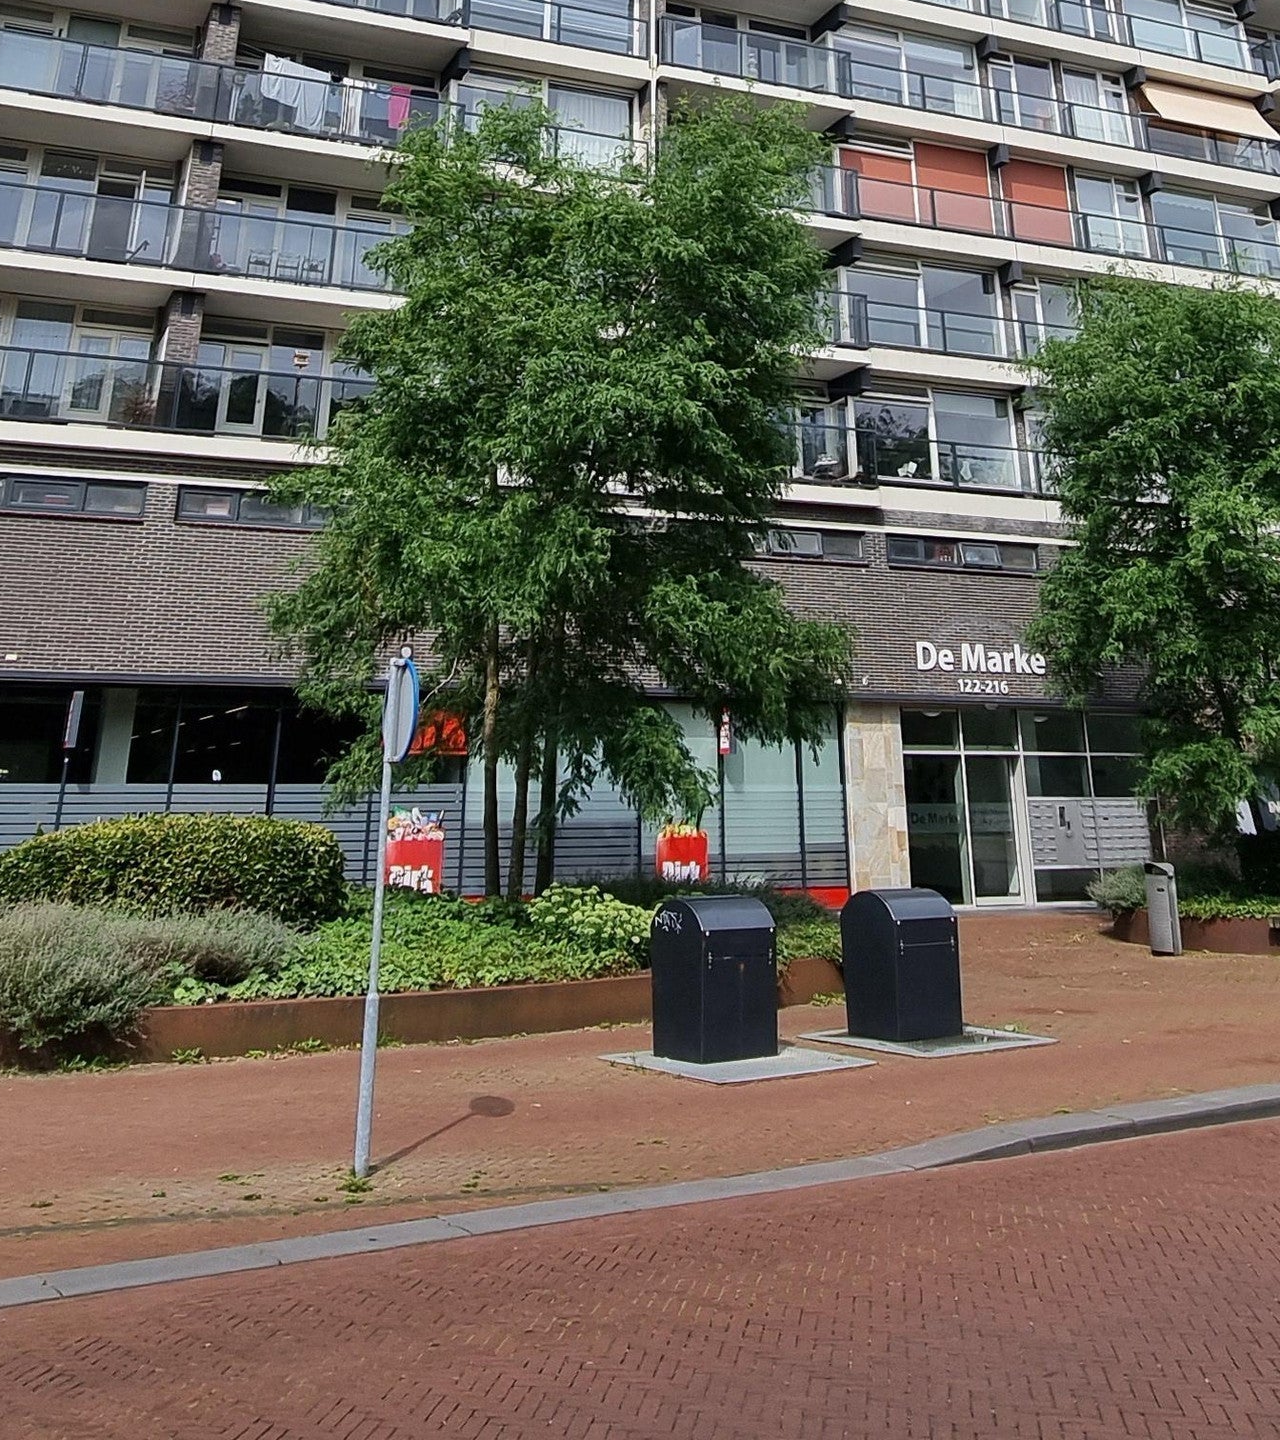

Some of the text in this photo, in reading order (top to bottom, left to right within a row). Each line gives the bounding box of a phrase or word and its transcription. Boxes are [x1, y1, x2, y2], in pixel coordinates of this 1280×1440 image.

[915, 641, 1047, 675] De Marke
[958, 678, 1010, 695] 122-216
[389, 865, 433, 894] Dirk
[662, 861, 700, 882] Dirk
